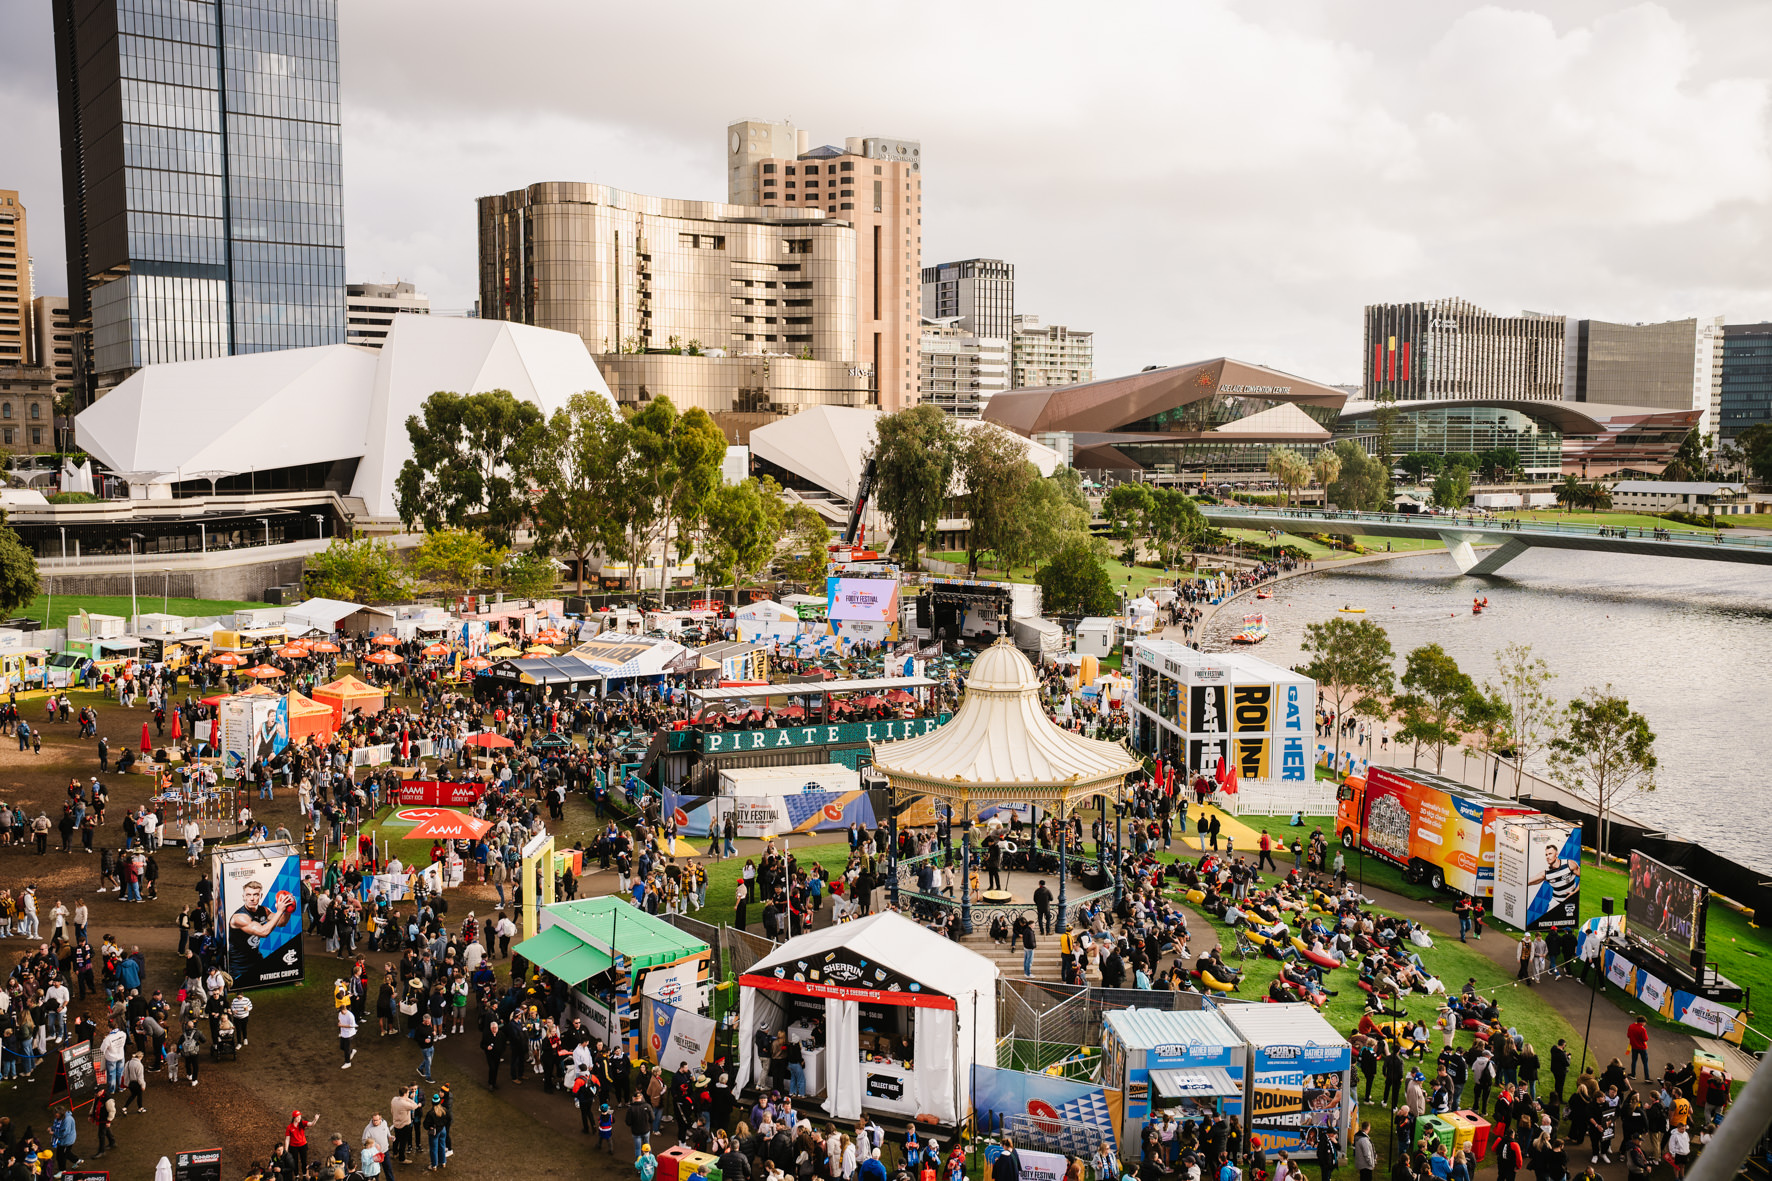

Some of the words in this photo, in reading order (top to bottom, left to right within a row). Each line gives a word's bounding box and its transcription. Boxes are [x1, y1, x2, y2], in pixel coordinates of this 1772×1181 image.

[1220, 384, 1243, 393] ADELAIDE
[1243, 385, 1272, 394] CONVENTION
[1272, 386, 1291, 394] CENTRE
[859, 595, 878, 603] FESTIVAL
[978, 609, 993, 618] FOOTY
[709, 726, 839, 751] PIRATE
[866, 718, 937, 740] LIFE
[1234, 687, 1270, 779] ROUND
[1282, 686, 1305, 782] GATHER
[402, 786, 424, 795] AAMI
[750, 809, 780, 820] FESTIVAL
[1460, 806, 1483, 818] sportsbet
[426, 826, 462, 834] AAMI
[260, 972, 280, 981] PATRICK
[280, 969, 299, 978] CRIPPS
[823, 962, 864, 978] SHERRIN
[815, 984, 826, 992] YOUR
[827, 986, 839, 994] NAME
[850, 988, 868, 997] SHERRIN
[794, 1000, 822, 1010] PERSONALISED
[578, 1000, 607, 1029] MERCHANDISE
[1692, 1008, 1705, 1018] FOOTY
[674, 1035, 684, 1045] FOOTY
[684, 1040, 700, 1052] FESTIVAL
[1154, 1044, 1187, 1054] SPORTS
[1190, 1046, 1207, 1055] GATHER
[1208, 1046, 1224, 1055] ROUND
[1264, 1046, 1302, 1056] SPORTS
[1304, 1048, 1324, 1058] GATHER
[1324, 1048, 1342, 1056] ROUND
[1254, 1073, 1303, 1086] GATHER
[870, 1080, 888, 1090] COLLECT
[888, 1084, 900, 1092] HERE
[1254, 1090, 1302, 1110] ROUND
[1678, 1104, 1688, 1116] 23
[1252, 1114, 1302, 1126] GATHER
[1034, 1171, 1056, 1180] FESTIVAL
